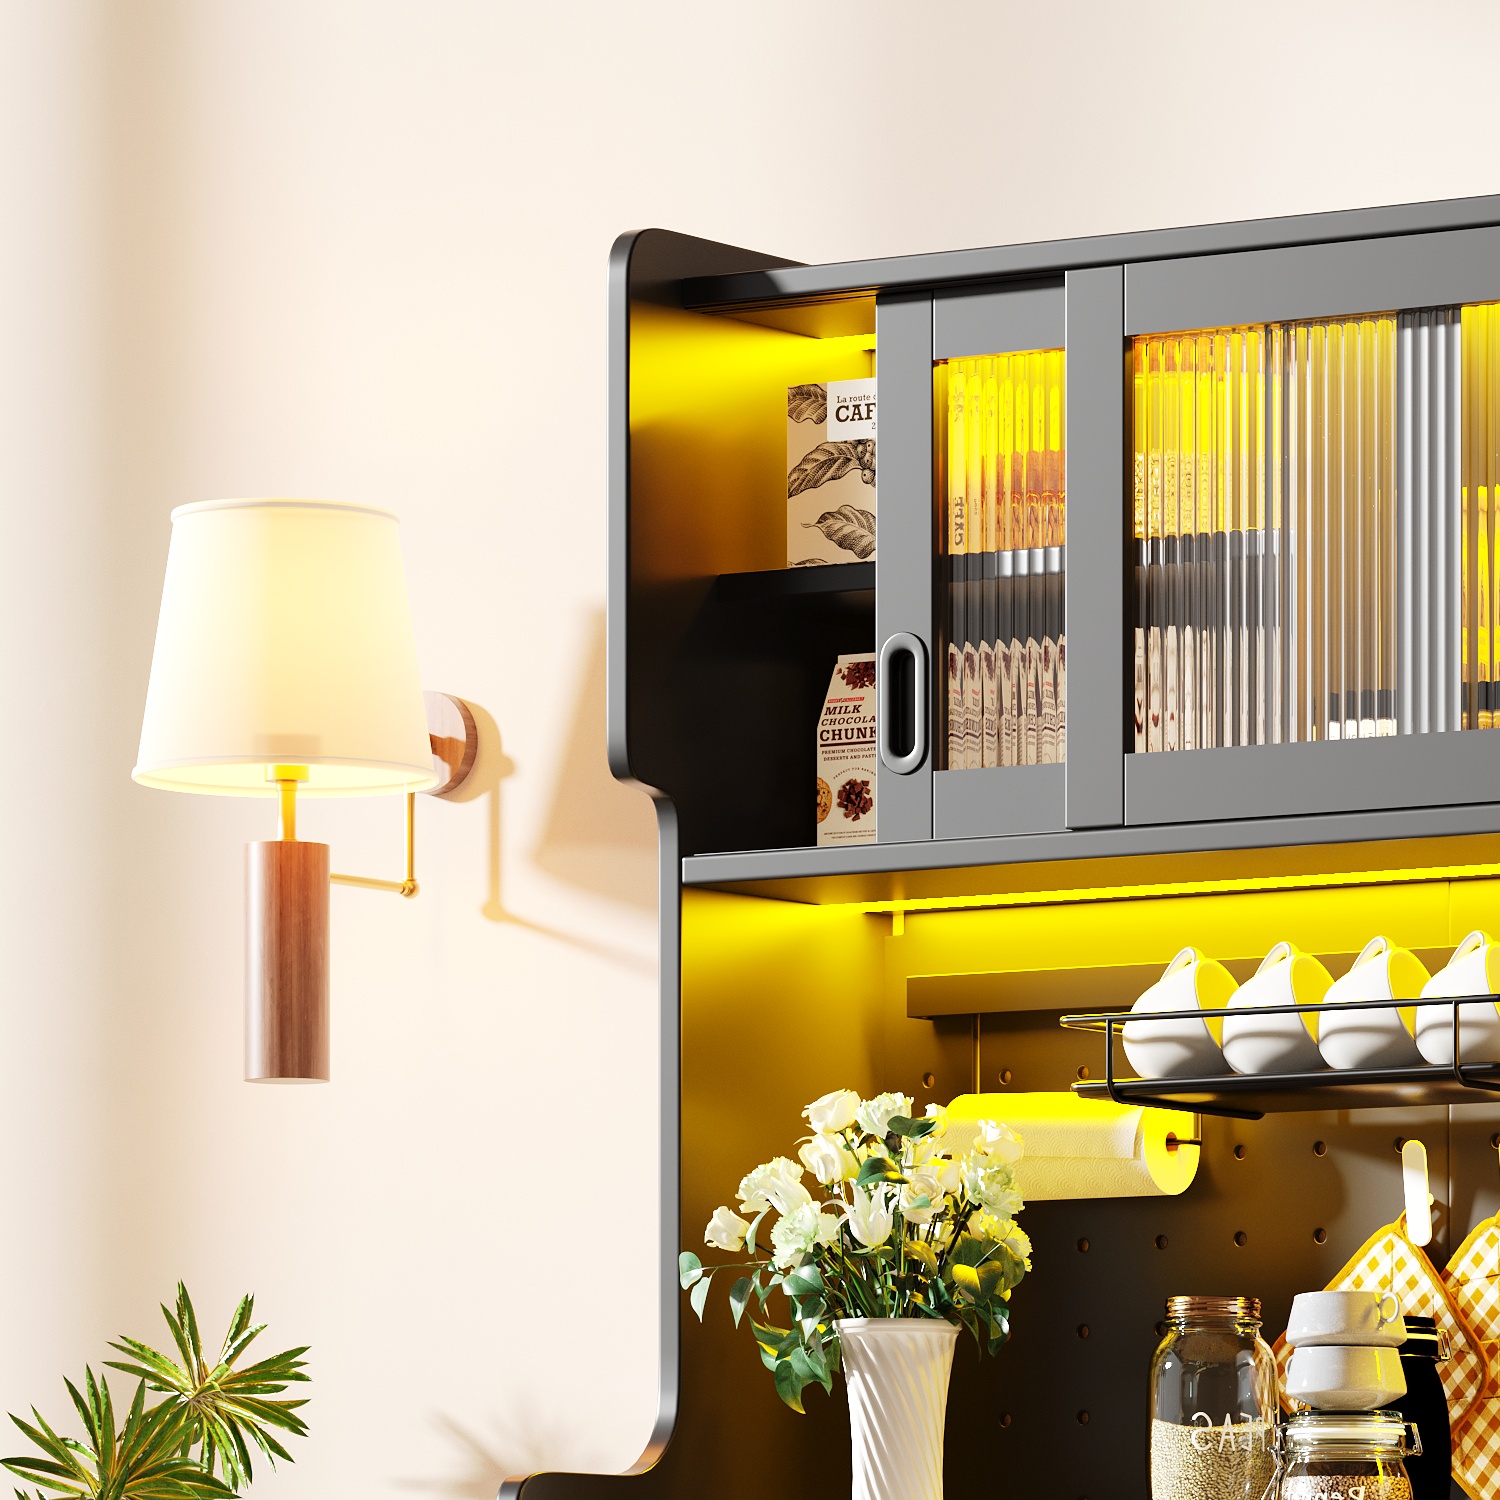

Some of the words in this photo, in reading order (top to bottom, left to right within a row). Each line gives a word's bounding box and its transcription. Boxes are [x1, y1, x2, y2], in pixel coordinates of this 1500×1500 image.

[849, 394, 871, 402] route
[835, 402, 876, 422] CAF
[824, 704, 862, 716] MILK
[821, 715, 876, 726] CHOCOLA
